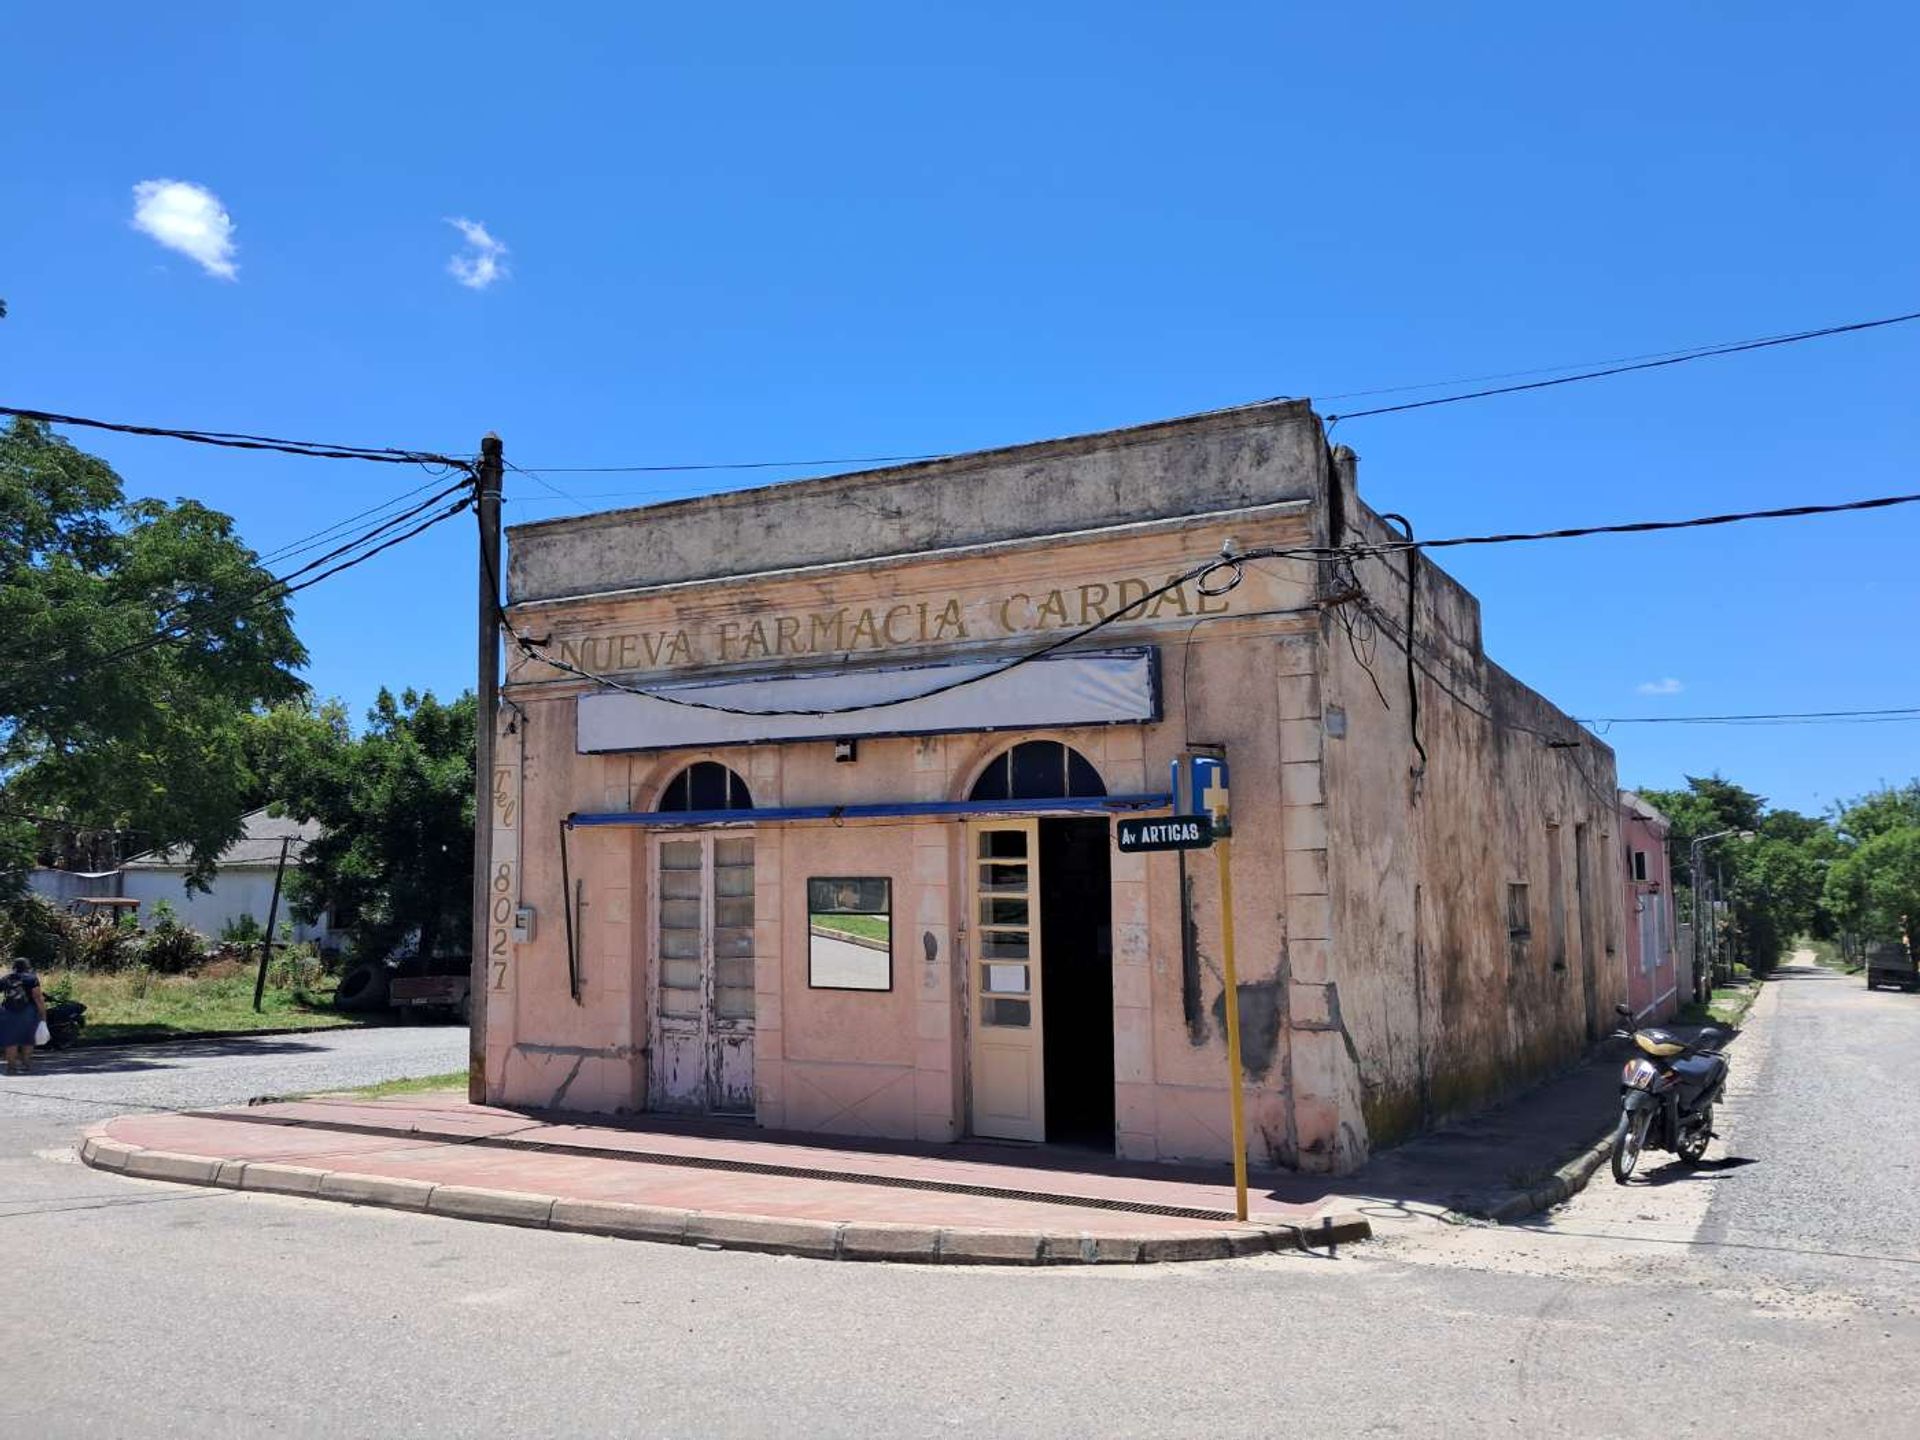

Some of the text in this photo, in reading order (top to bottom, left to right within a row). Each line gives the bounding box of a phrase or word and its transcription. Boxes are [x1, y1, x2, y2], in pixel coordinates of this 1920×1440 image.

[559, 573, 1230, 673] NUEVA FARMACIA CARDAL
[492, 769, 516, 991] Tel 8027
[1141, 823, 1199, 843] ARTIGAS
